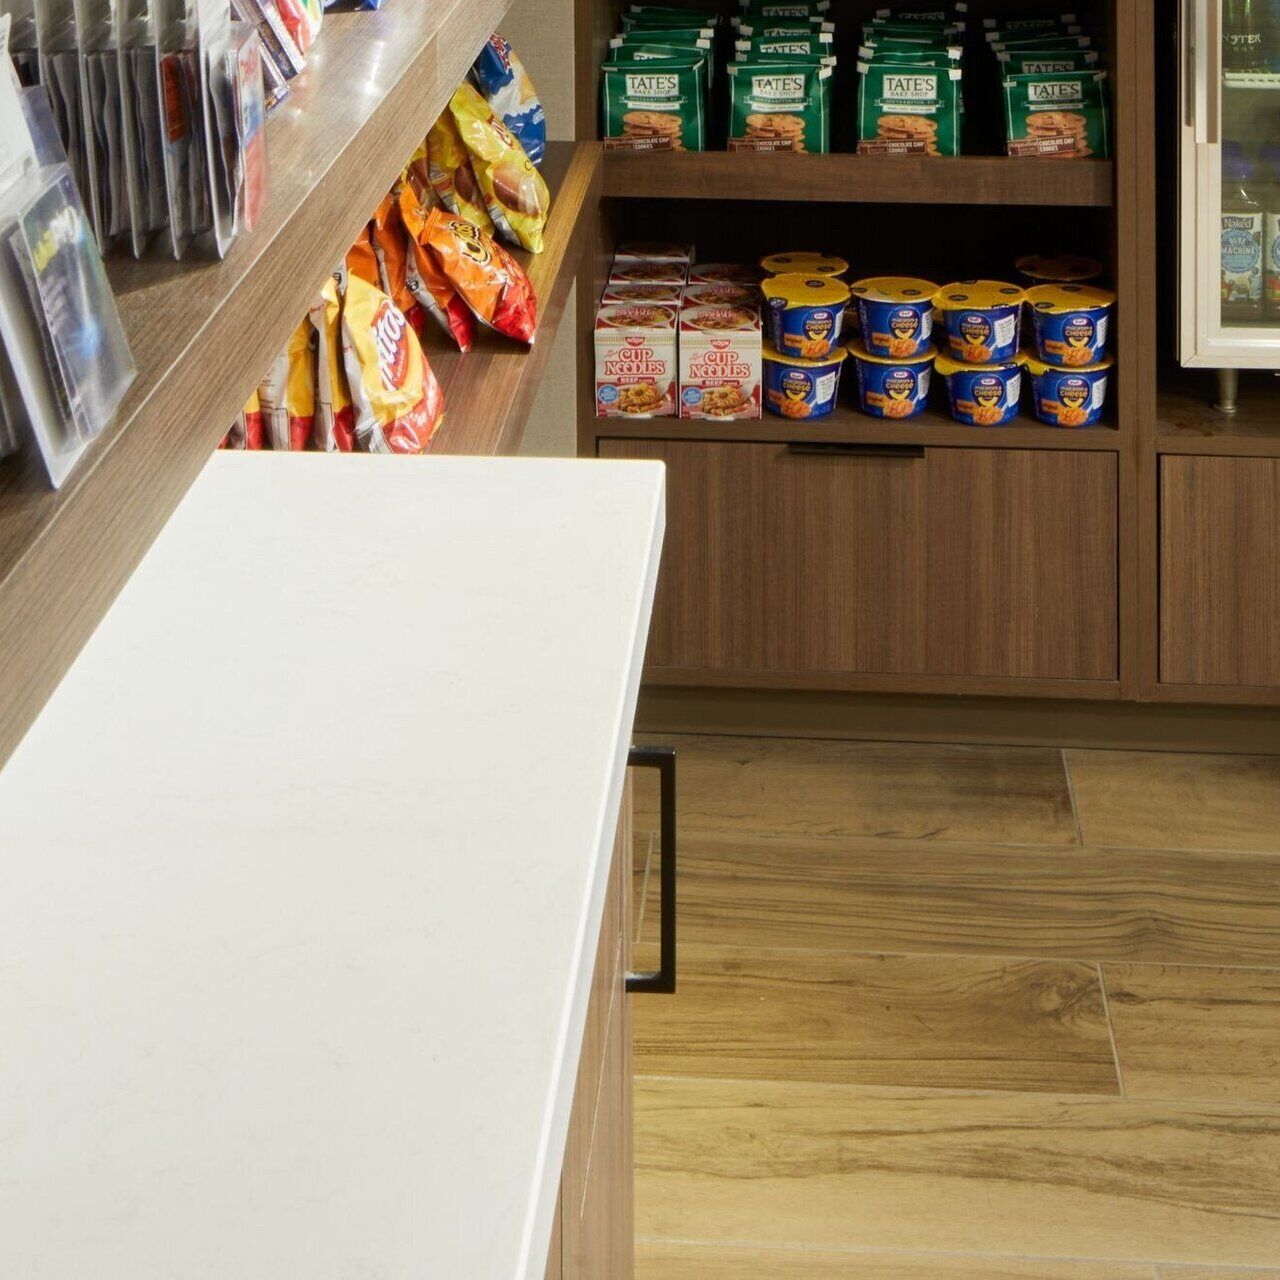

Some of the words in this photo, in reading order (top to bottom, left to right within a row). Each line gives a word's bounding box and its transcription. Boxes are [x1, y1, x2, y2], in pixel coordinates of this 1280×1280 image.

[762, 43, 810, 55] TATE'S
[627, 75, 677, 90] TATE'S
[754, 77, 803, 91] TATE'S
[885, 77, 935, 92] TATE'S
[1030, 83, 1080, 96] TATE'S
[1039, 138, 1064, 147] CHOCOLATE
[618, 348, 653, 362] CUP
[703, 351, 739, 365] CUP
[605, 360, 665, 376] NOODLES
[689, 363, 751, 379] NOODLES
